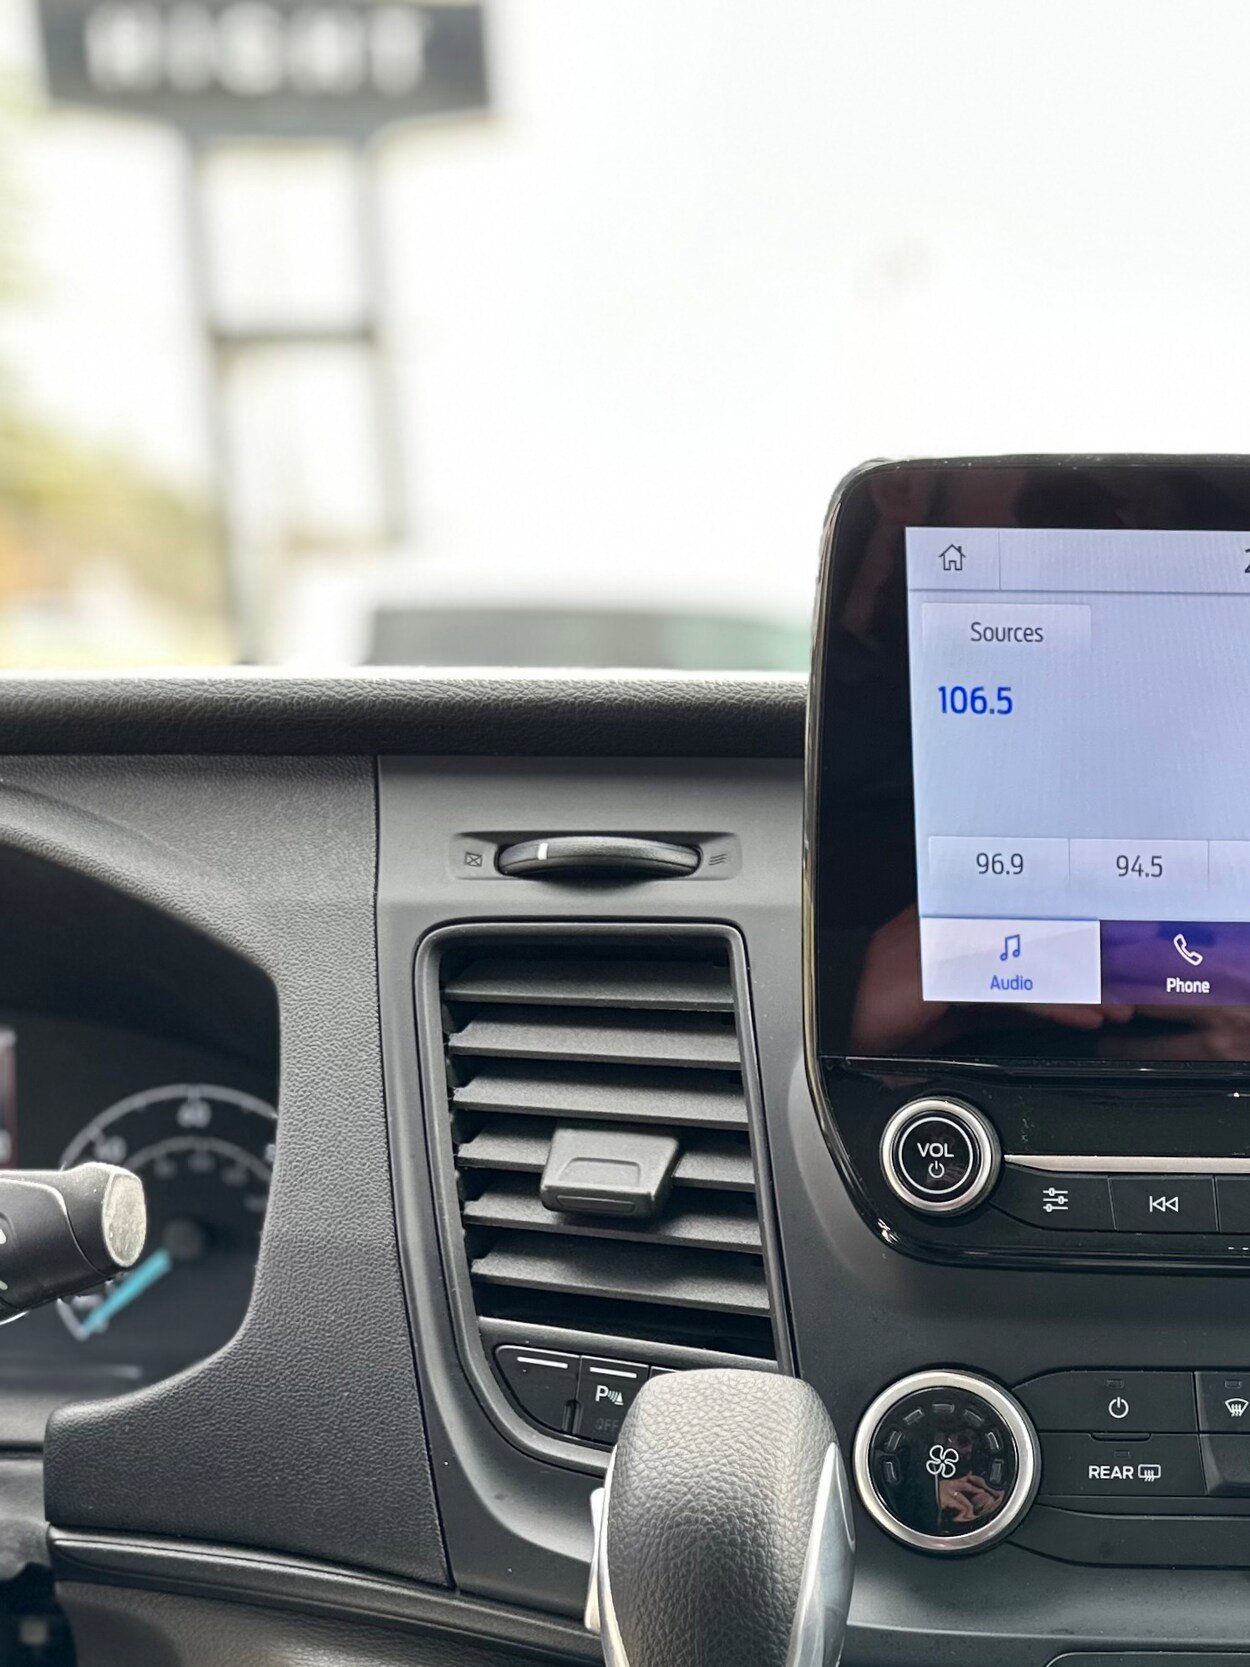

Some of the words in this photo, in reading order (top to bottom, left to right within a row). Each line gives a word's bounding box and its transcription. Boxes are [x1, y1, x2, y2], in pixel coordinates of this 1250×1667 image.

[970, 621, 1044, 643] Sources
[938, 685, 1013, 715] 106.5
[975, 852, 1024, 876] 96.9
[1115, 854, 1163, 878] 94.5
[990, 974, 1034, 991] Audio
[1165, 977, 1211, 994] Phone
[916, 1142, 955, 1158] VOL
[1088, 1465, 1134, 1480] REAR
